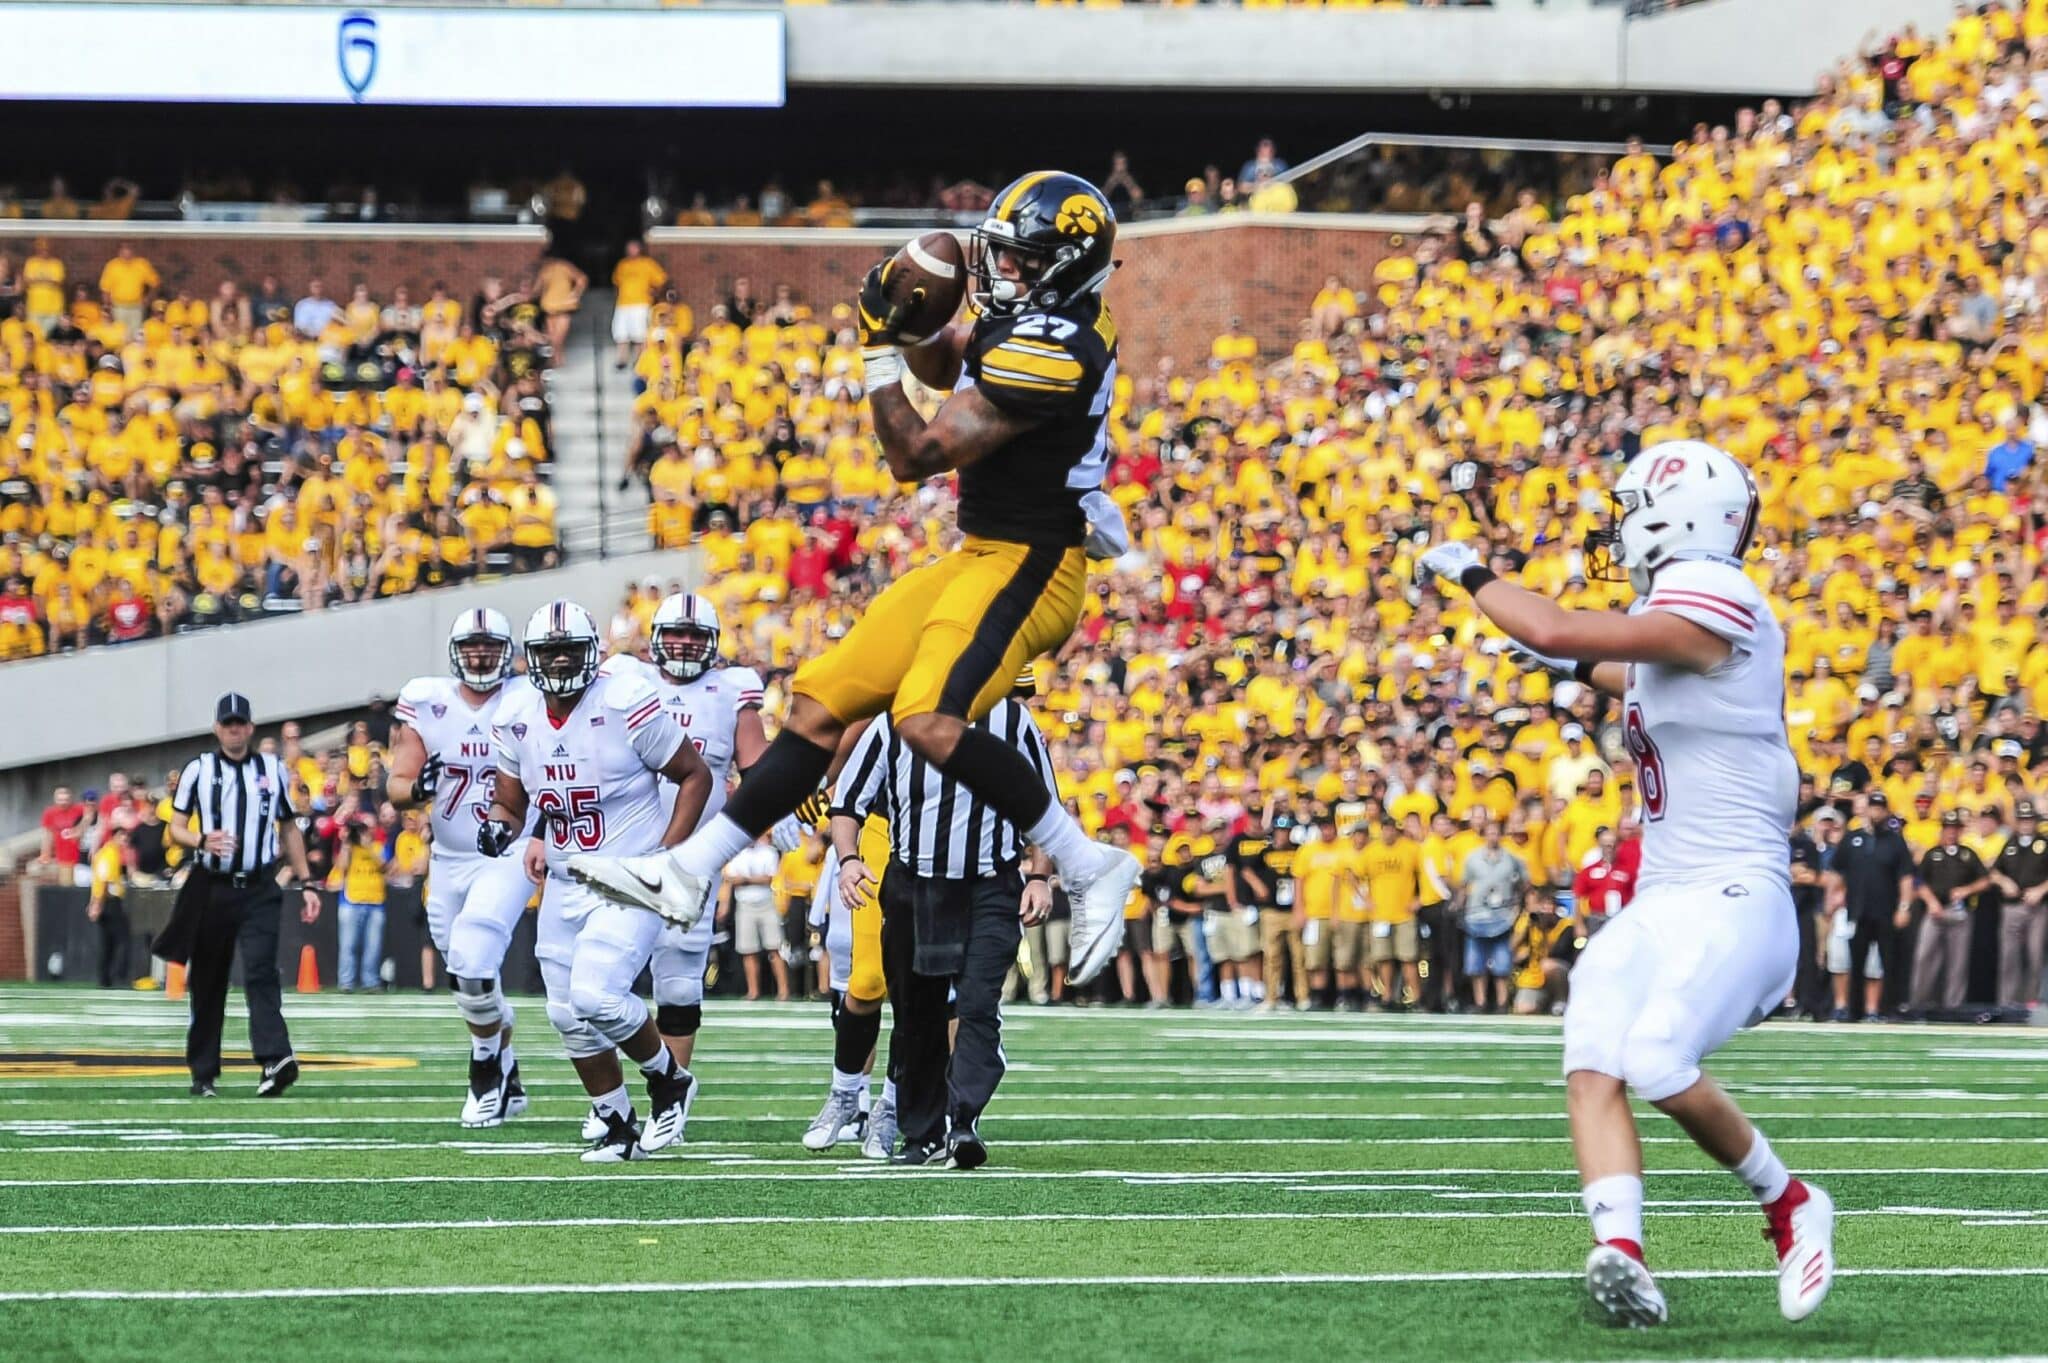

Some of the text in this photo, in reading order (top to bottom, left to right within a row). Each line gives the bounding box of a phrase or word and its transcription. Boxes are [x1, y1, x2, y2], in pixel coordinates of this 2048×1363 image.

[1012, 313, 1078, 340] 27
[460, 742, 490, 758] NIU
[543, 763, 577, 782] NIU
[535, 785, 606, 852] 65
